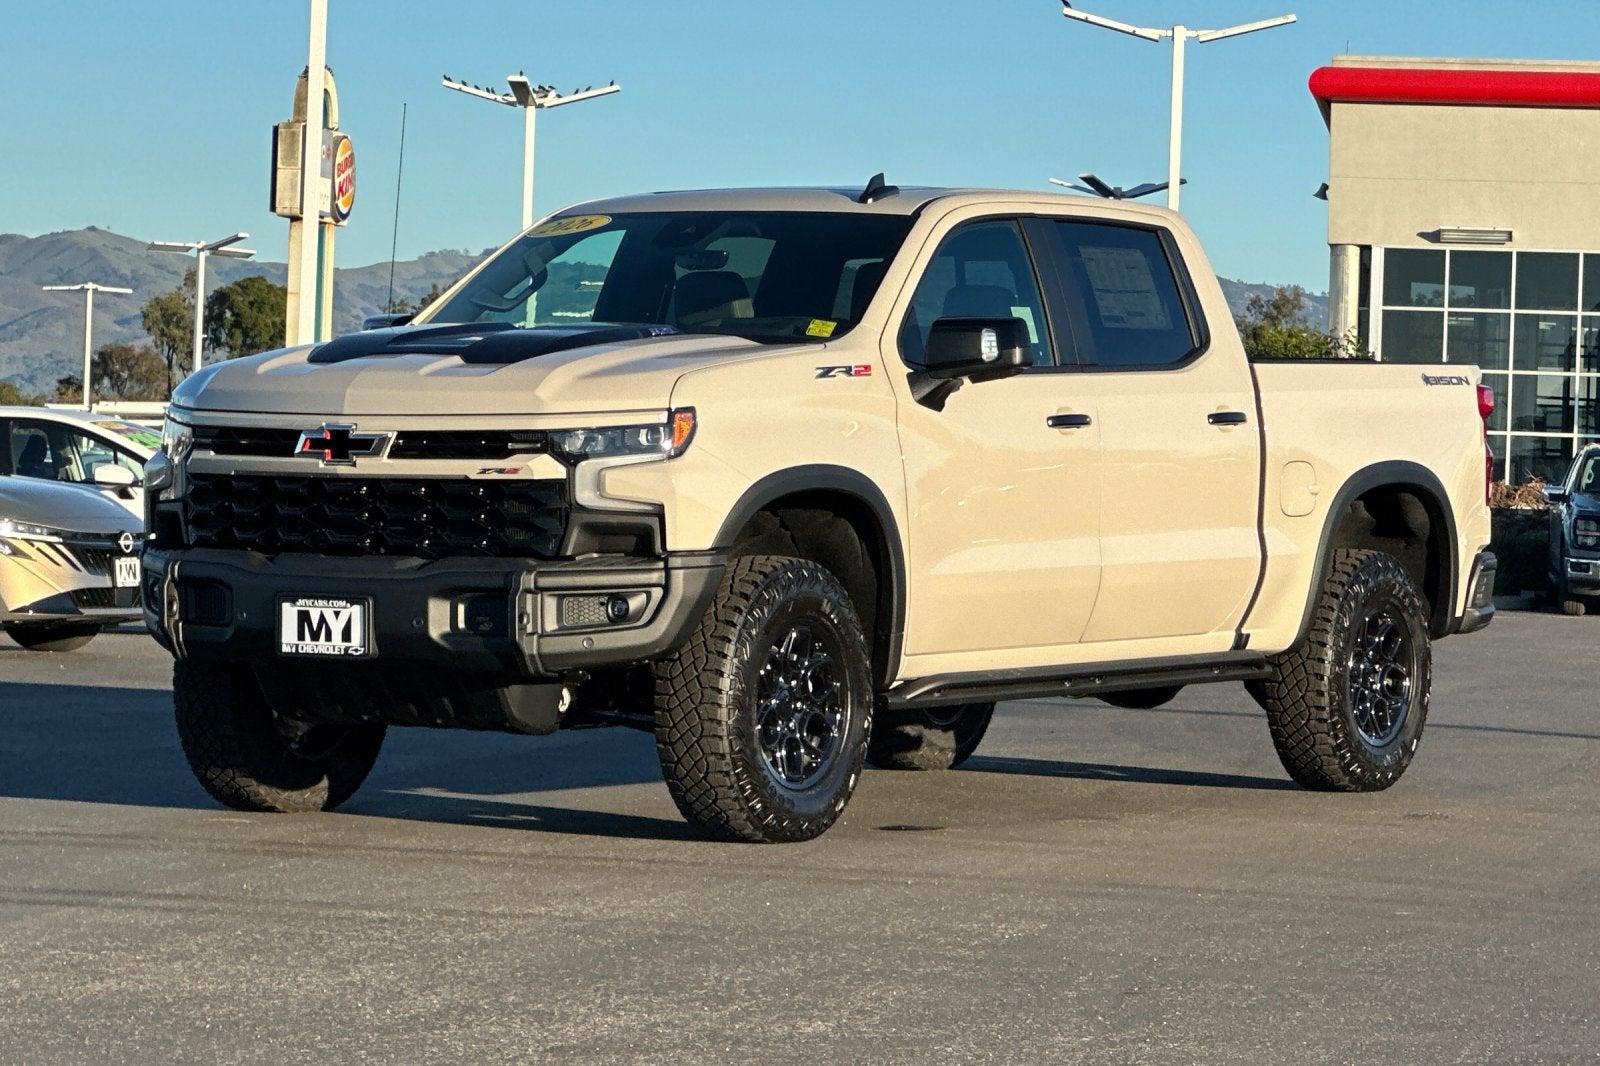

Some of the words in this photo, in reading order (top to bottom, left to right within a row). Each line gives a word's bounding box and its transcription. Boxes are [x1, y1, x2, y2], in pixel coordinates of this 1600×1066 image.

[815, 365, 871, 379] ZR2
[1427, 376, 1470, 385] BISON
[297, 609, 352, 643] MY
[282, 644, 296, 653] MY
[298, 645, 345, 655] CHEVROLET
